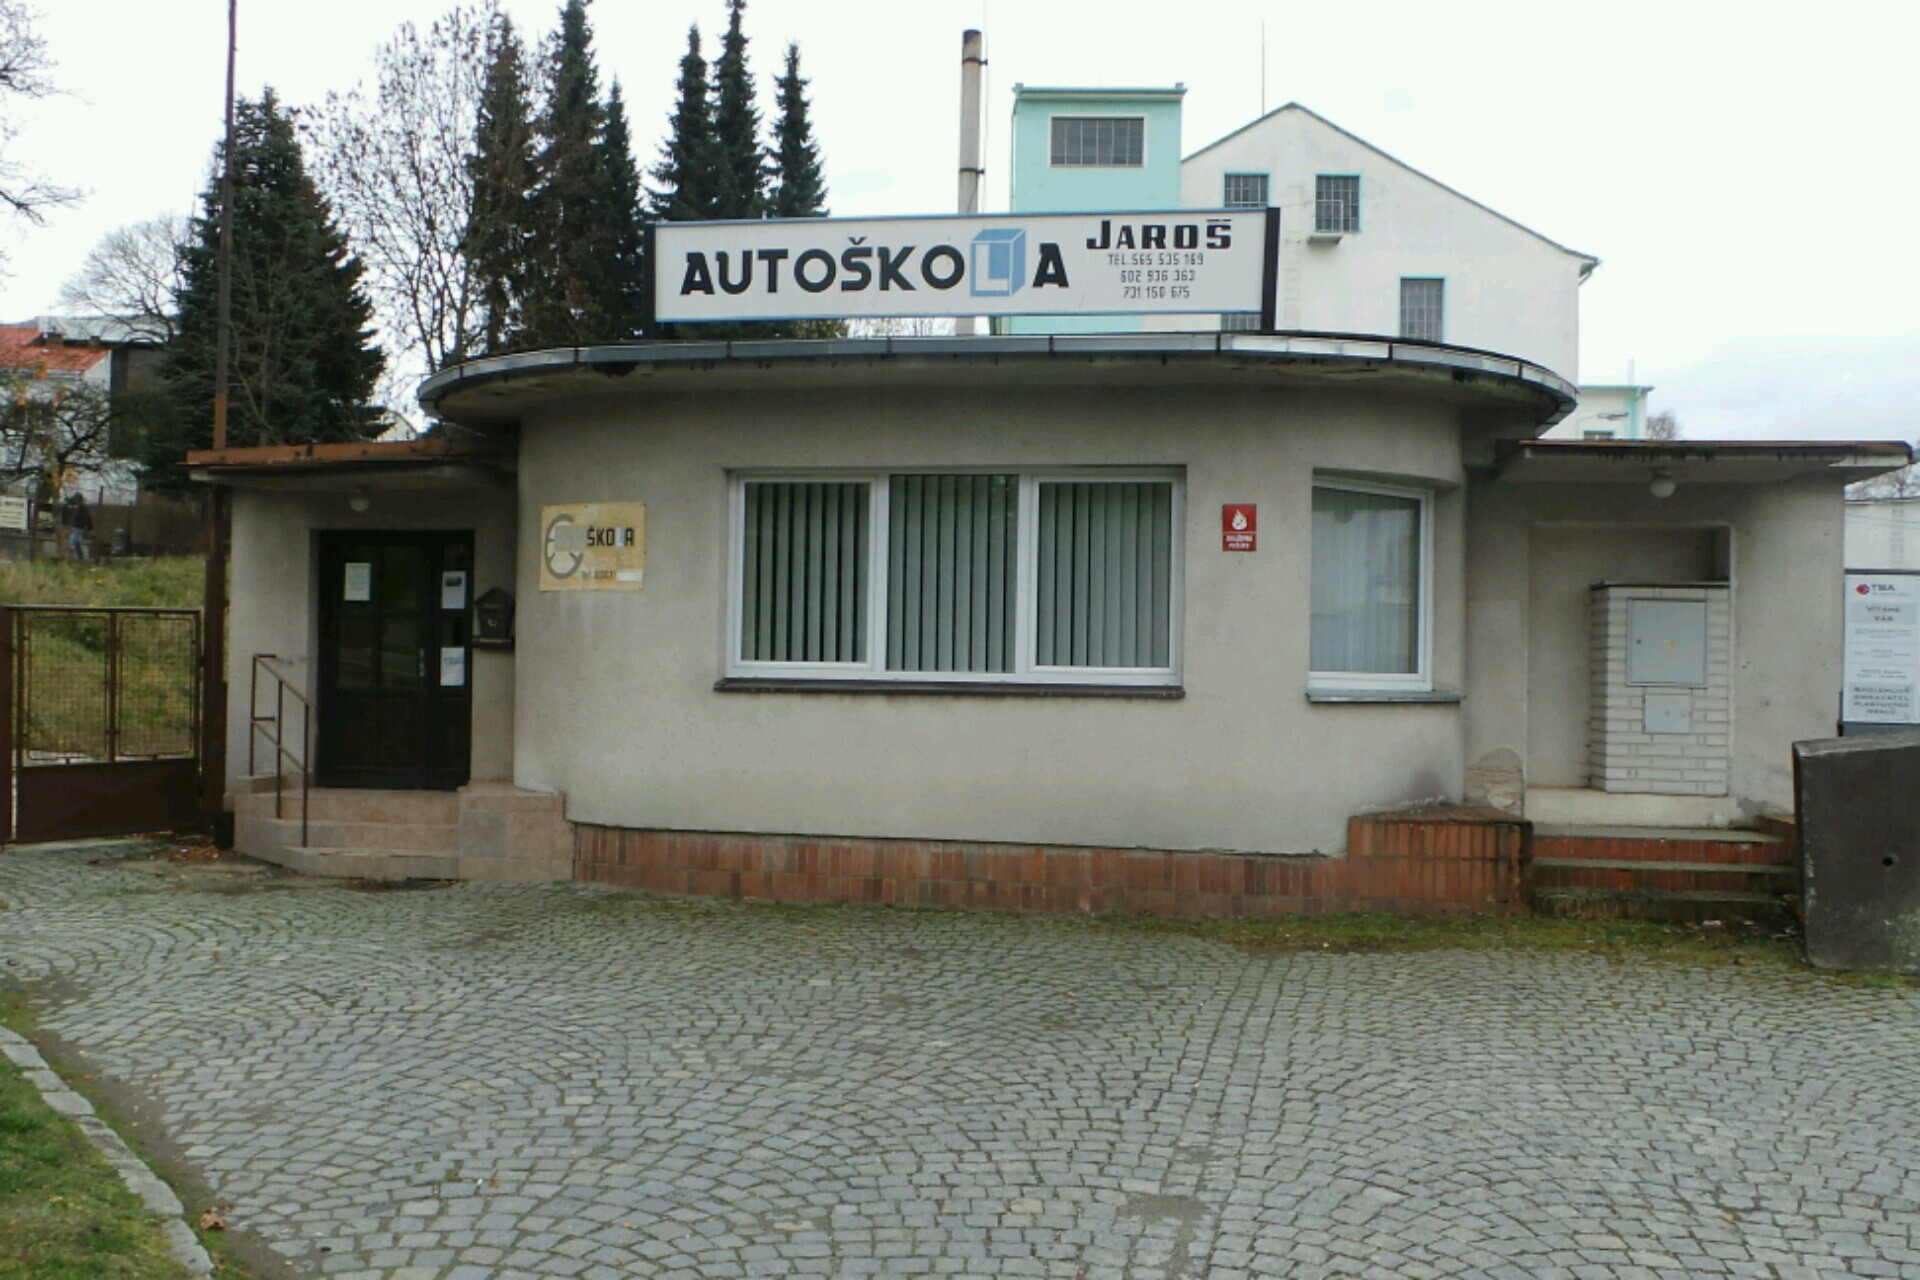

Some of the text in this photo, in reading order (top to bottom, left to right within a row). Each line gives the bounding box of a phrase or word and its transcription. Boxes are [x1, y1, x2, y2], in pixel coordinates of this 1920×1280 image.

[1086, 219, 1232, 250] JAROŠ
[680, 229, 1070, 297] AUTOŠKOLA
[1158, 252, 1180, 266] 535
[1120, 269, 1142, 283] 602
[1173, 269, 1196, 282] 363
[1123, 285, 1141, 299] 731
